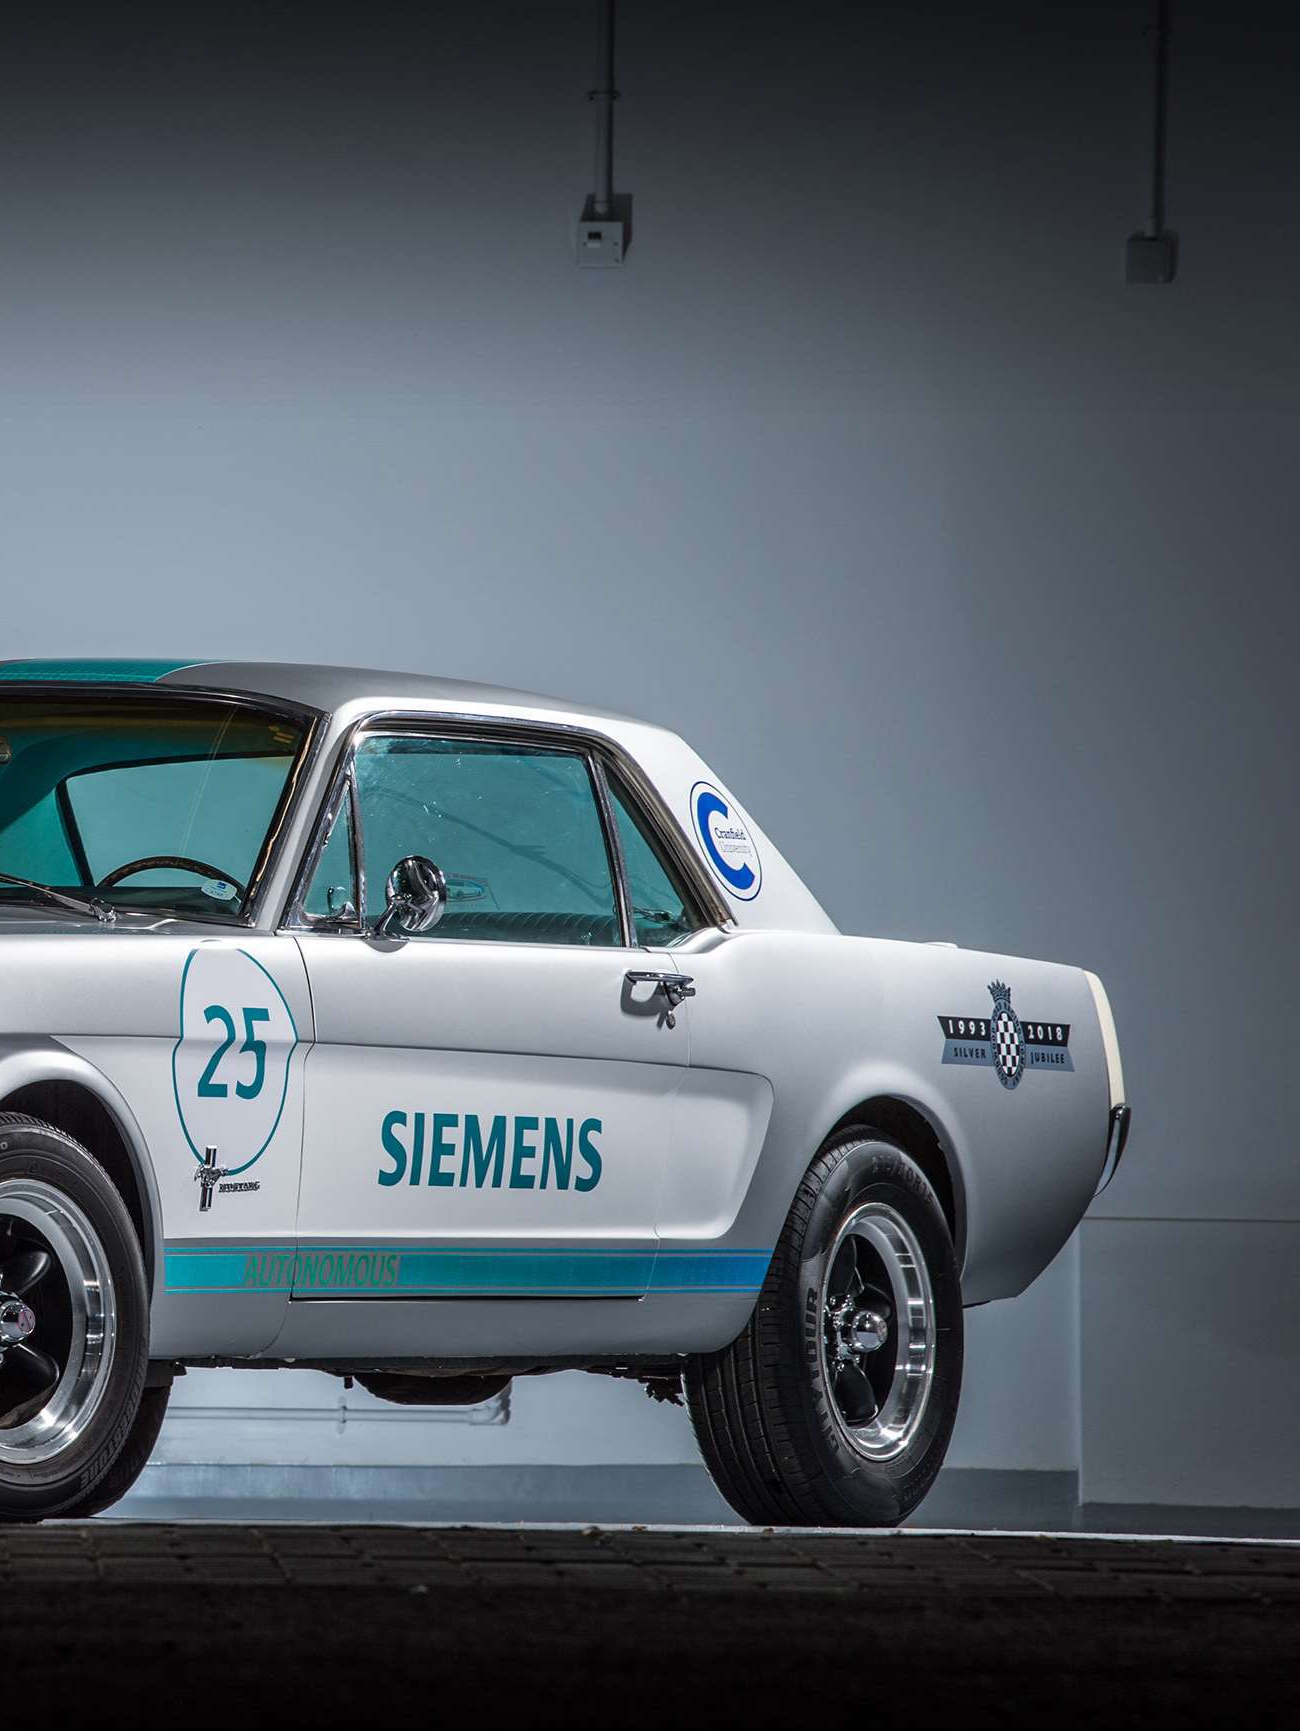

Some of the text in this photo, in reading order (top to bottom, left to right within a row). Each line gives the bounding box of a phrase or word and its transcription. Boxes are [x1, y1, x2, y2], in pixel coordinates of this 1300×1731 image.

[948, 1019, 1064, 1041] 1993 2018
[197, 1004, 270, 1099] 25
[953, 1047, 1065, 1065] SILVER JUBILEE
[377, 1109, 603, 1192] SIEMENS
[244, 1253, 398, 1287] AUTONOMOUS
